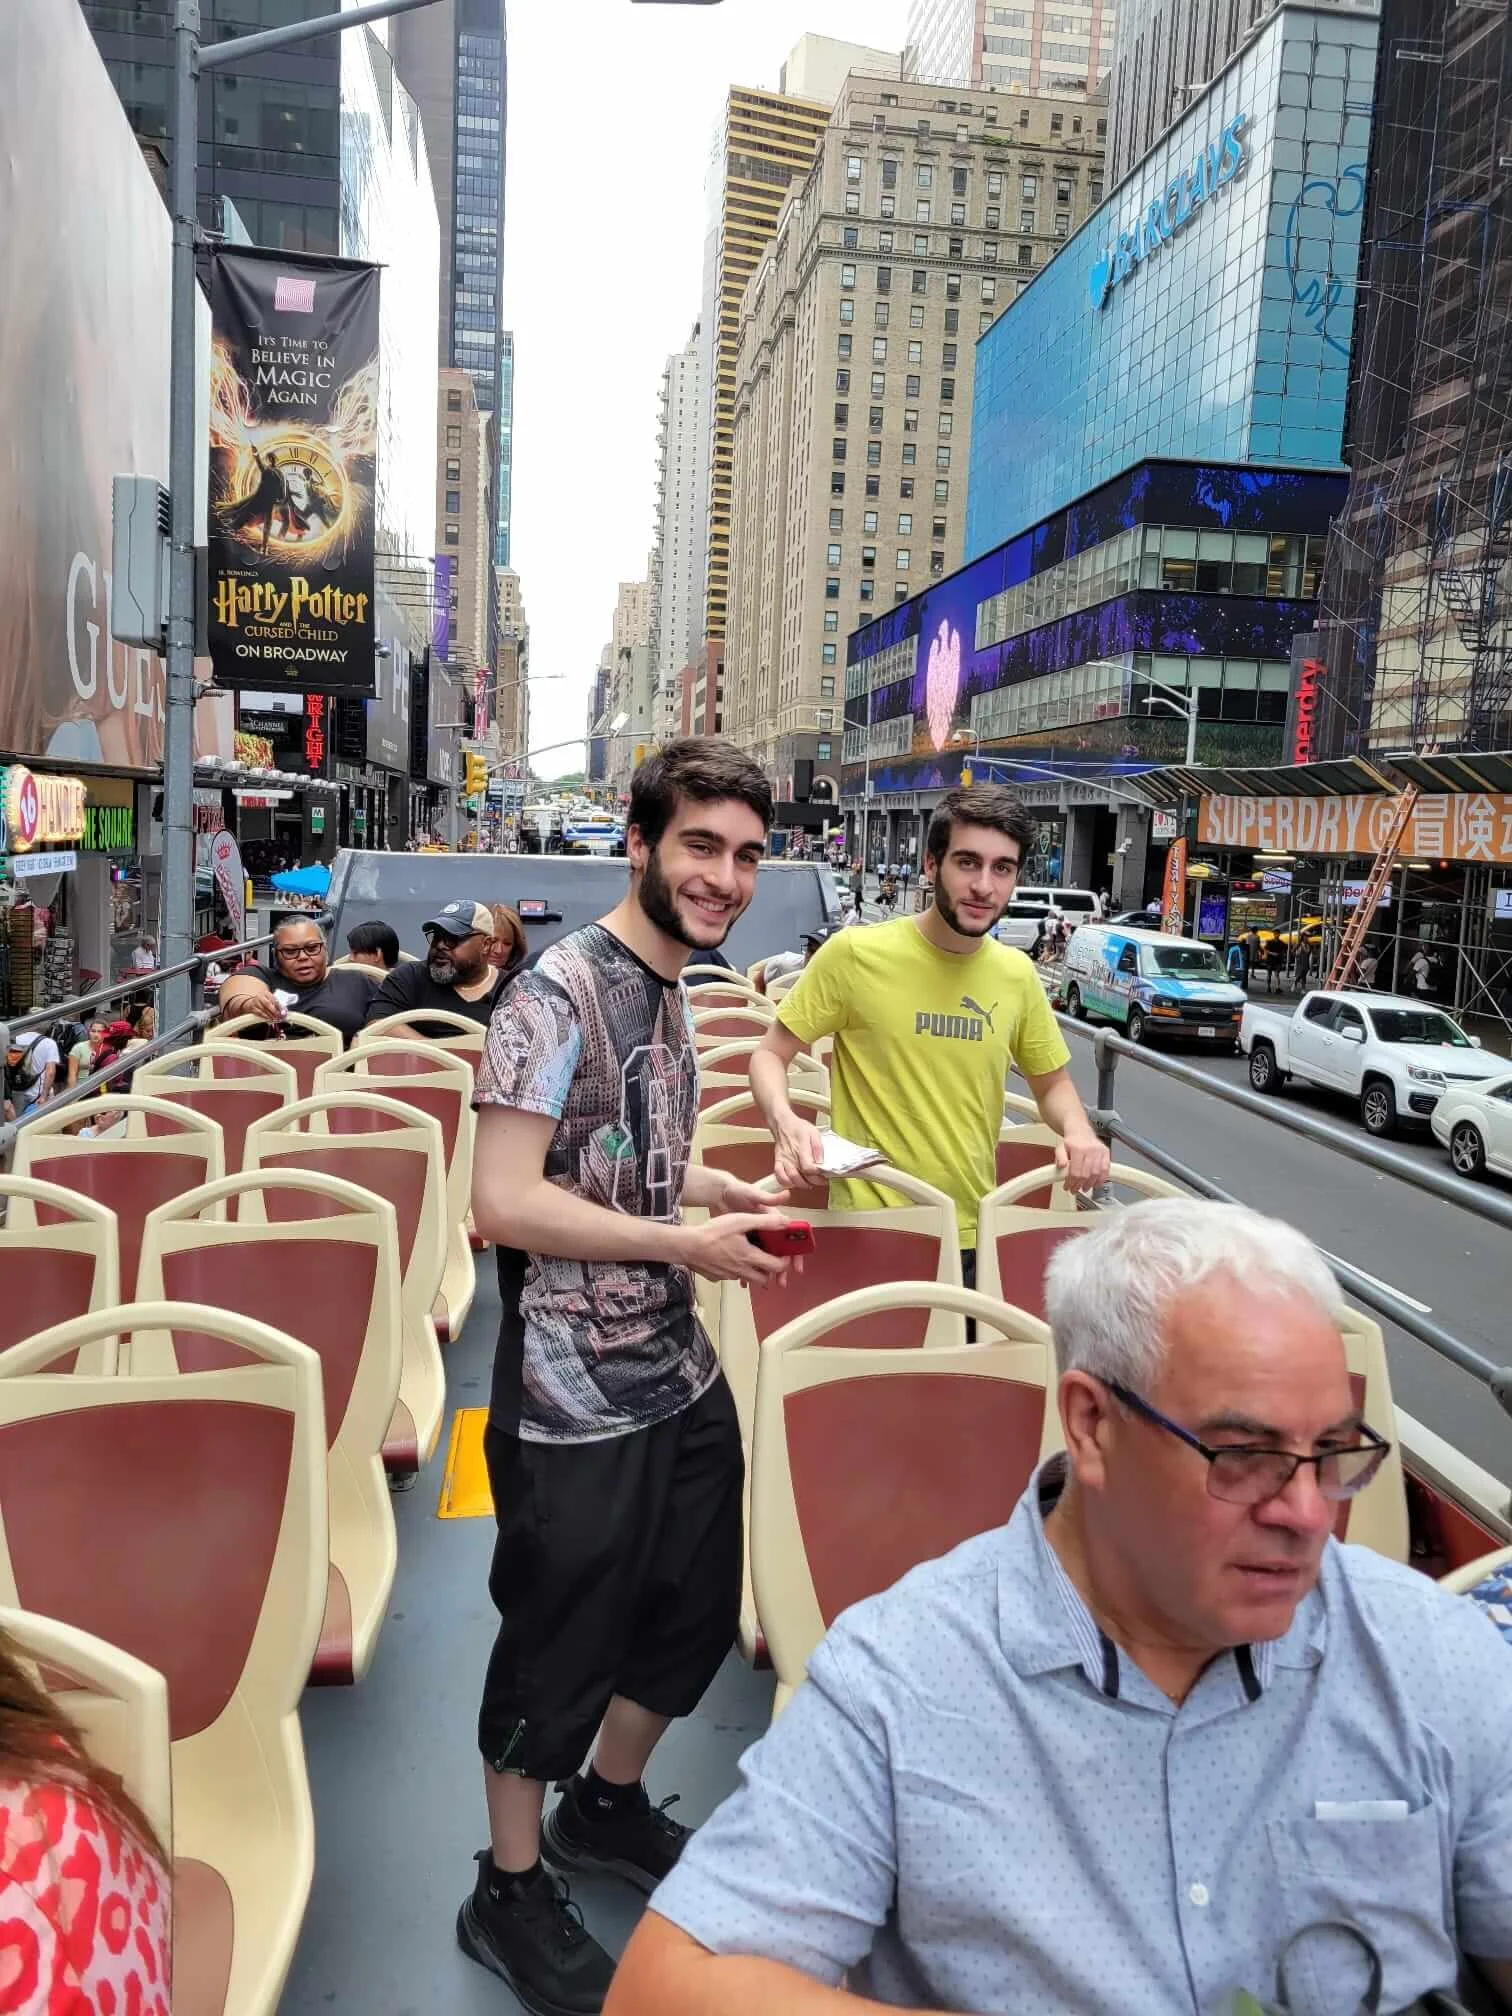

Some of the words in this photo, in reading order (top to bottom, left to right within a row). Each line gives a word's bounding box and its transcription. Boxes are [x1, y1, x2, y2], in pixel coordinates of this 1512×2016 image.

[1111, 113, 1246, 286] BARCLAYS
[280, 336, 308, 349] TIME
[312, 338, 328, 350] TO
[252, 349, 309, 365] BELIEVE
[317, 355, 336, 368] IN
[255, 366, 332, 388] MAGIC
[267, 388, 317, 405] AGAIN
[212, 577, 289, 627] Harry
[289, 576, 369, 634] Potter
[244, 625, 294, 639] CURSED
[298, 629, 338, 642] CHILD
[235, 644, 259, 657] ON
[264, 646, 349, 662] BROADWAY
[1206, 794, 1362, 852] SUPERDRY
[915, 1010, 983, 1042] PUMA
